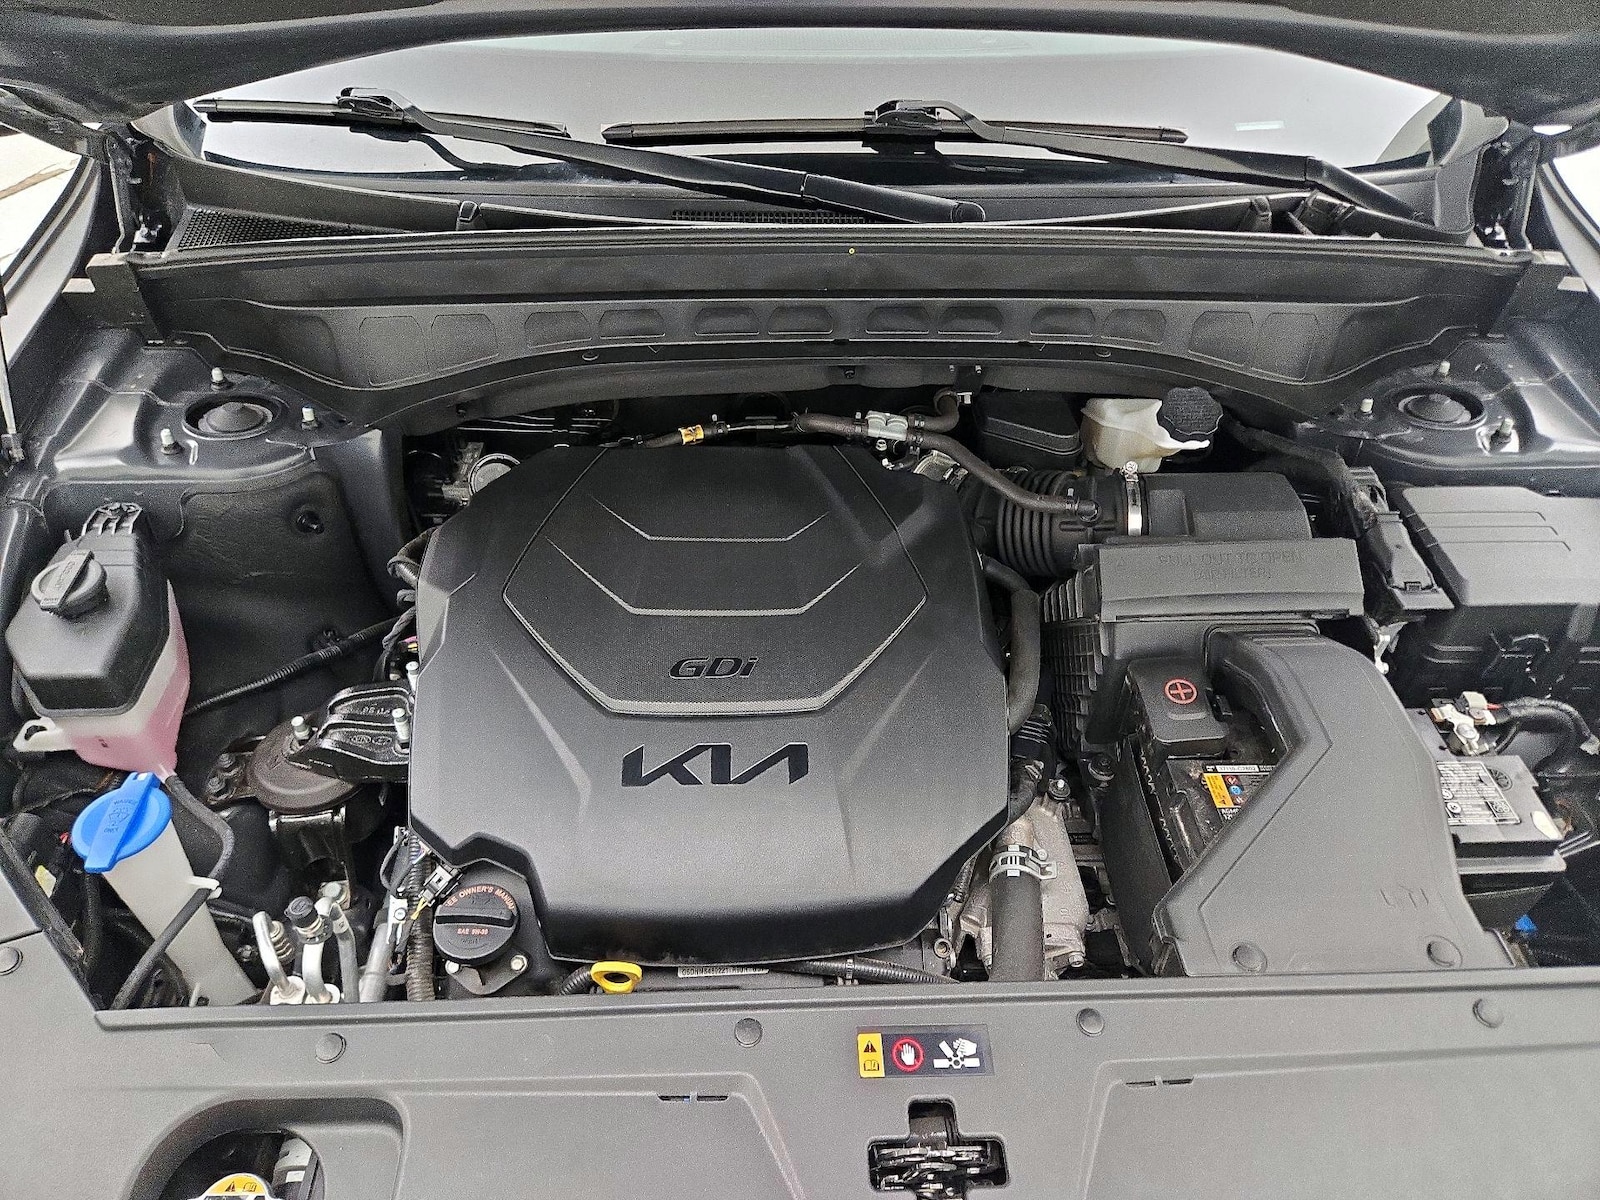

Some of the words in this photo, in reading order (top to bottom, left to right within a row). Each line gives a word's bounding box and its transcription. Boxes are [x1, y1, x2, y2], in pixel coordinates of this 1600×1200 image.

[669, 655, 760, 679] GDi
[621, 741, 809, 787] KIA
[458, 885, 494, 898] OWNER'S
[495, 889, 516, 909] MANUA
